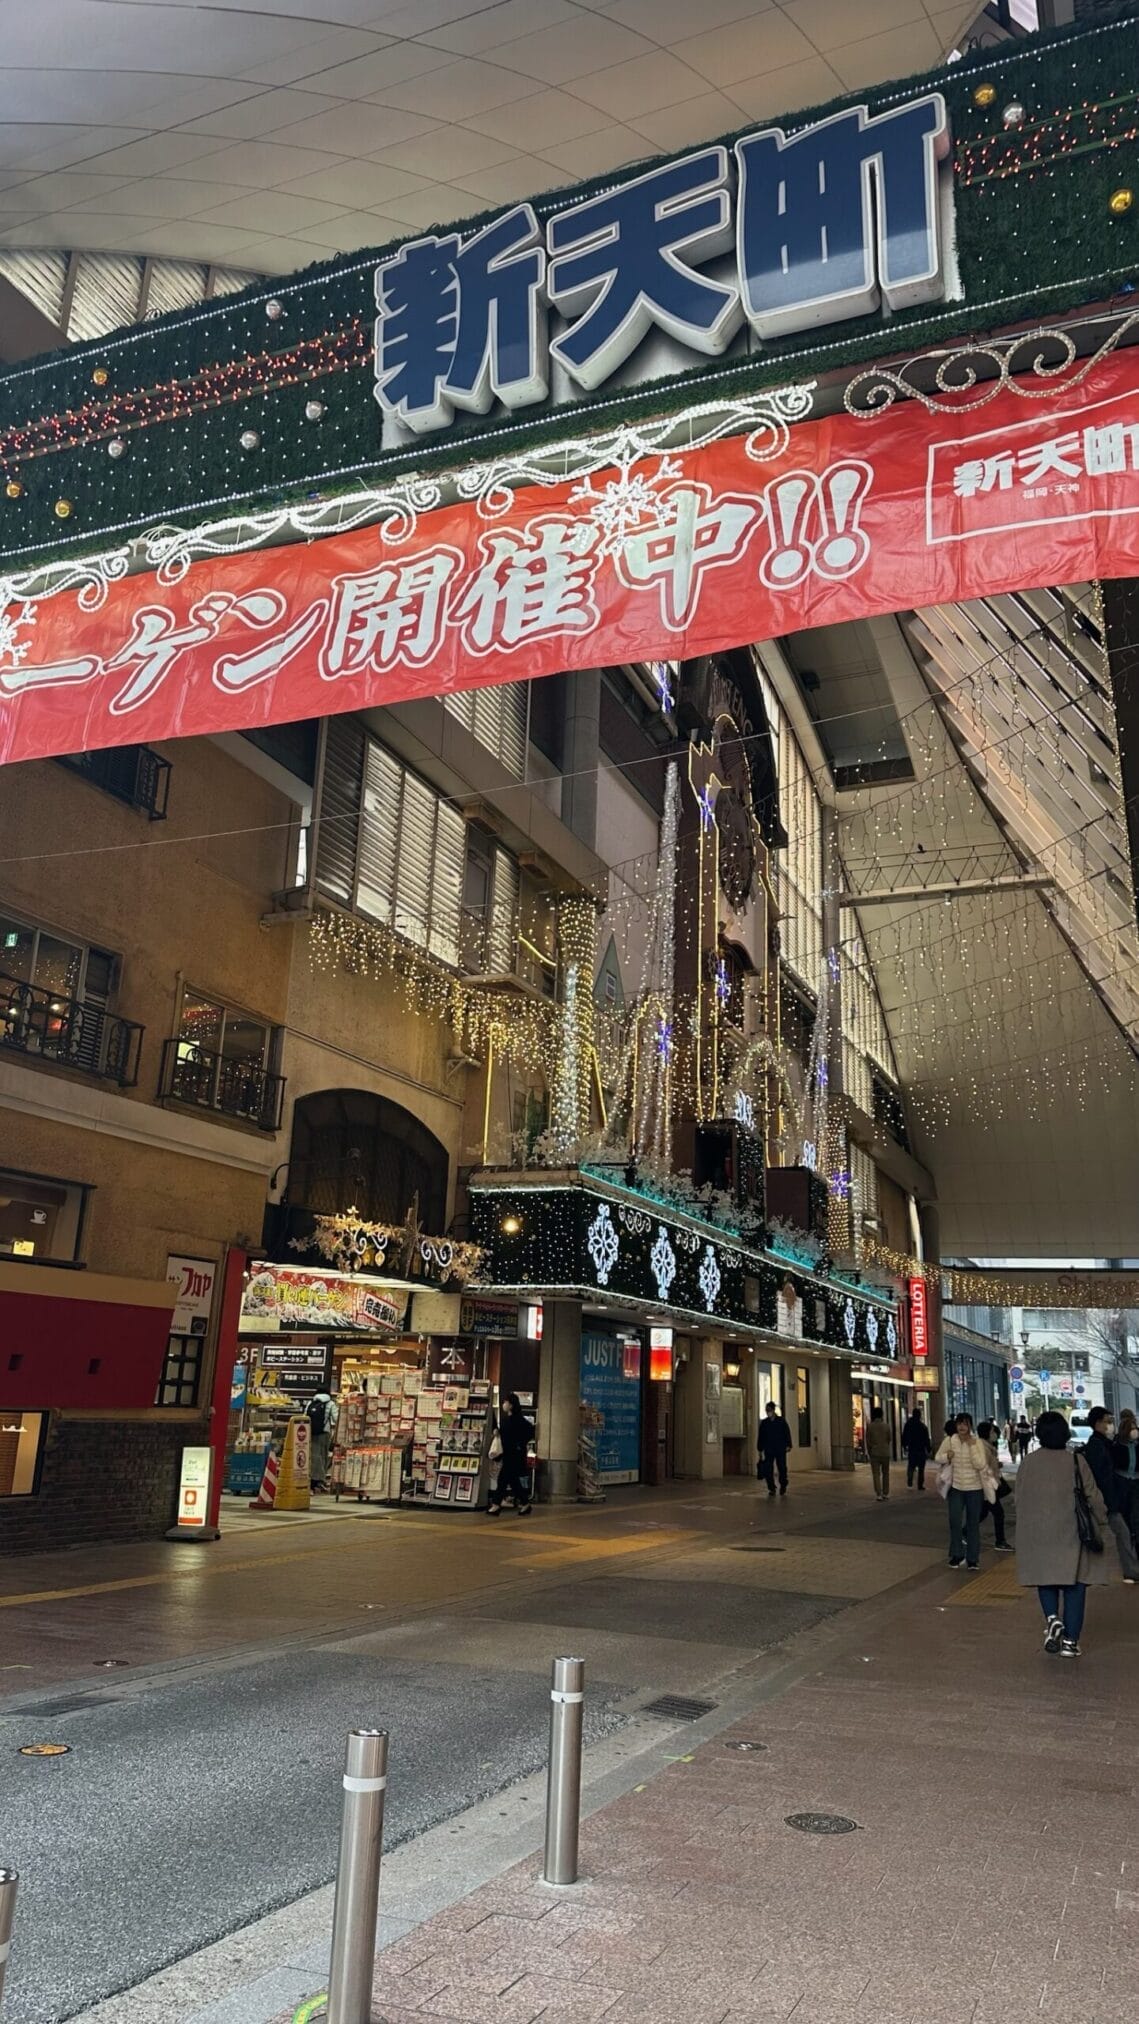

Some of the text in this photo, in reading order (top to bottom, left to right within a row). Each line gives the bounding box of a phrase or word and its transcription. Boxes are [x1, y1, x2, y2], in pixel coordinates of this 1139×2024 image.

[374, 93, 947, 428] 新天町
[953, 422, 1139, 497] 新天町
[913, 1284, 925, 1349] LOTTERIA
[240, 1347, 259, 1363] 3F
[440, 1347, 466, 1370] 本
[584, 1338, 616, 1368] JUST
